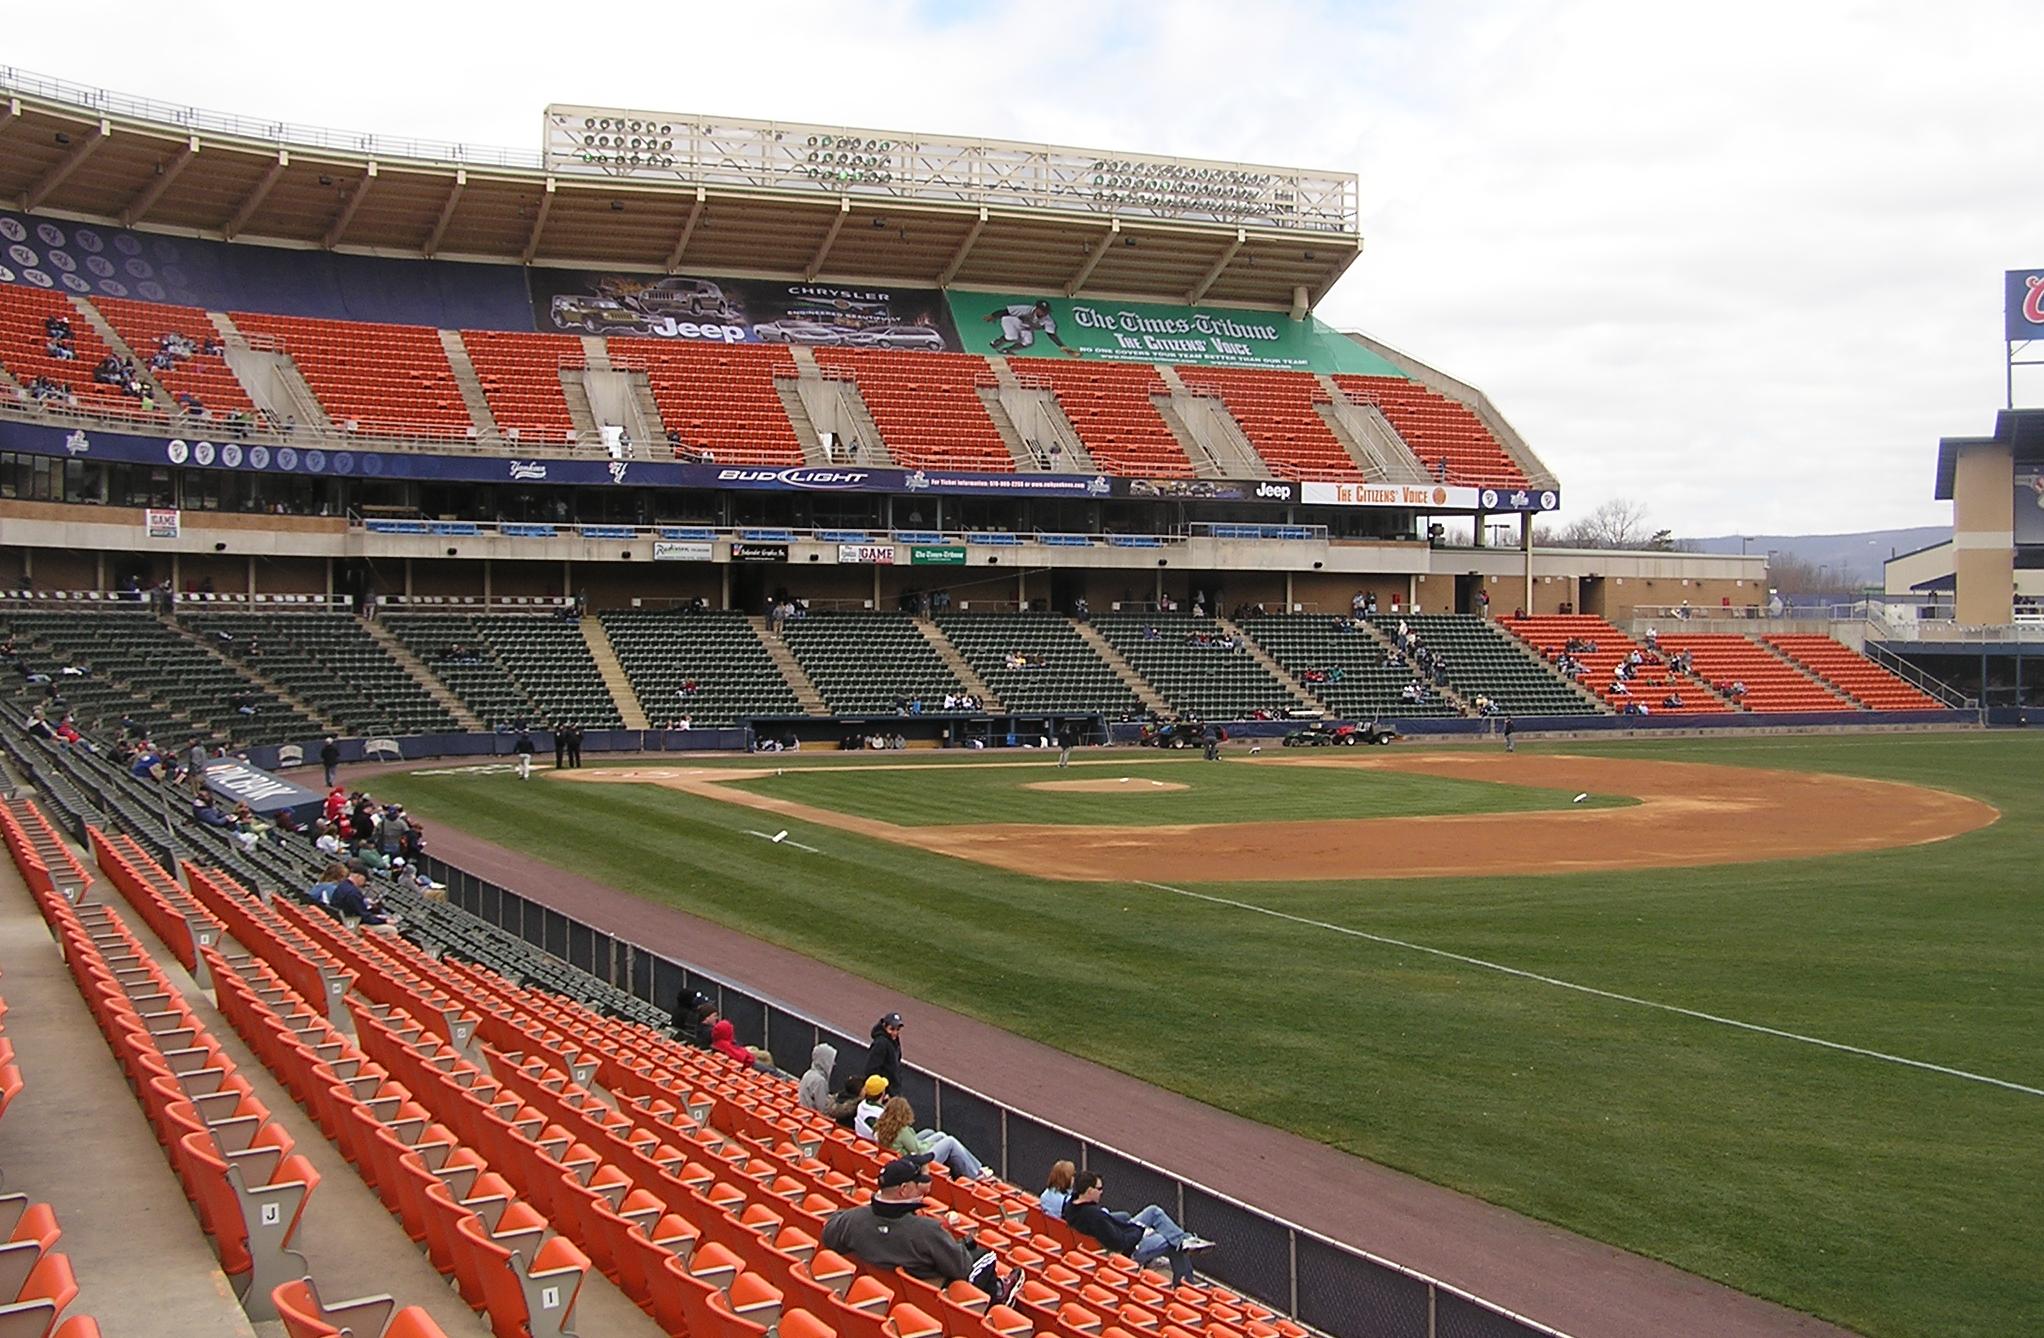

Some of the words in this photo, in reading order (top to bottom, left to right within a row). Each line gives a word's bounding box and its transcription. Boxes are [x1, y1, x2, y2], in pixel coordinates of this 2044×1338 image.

[788, 287, 891, 300] CHRYSLER
[654, 318, 745, 344] Jeep
[1072, 306, 1117, 330] The
[1118, 311, 1279, 340] Times-Tribune
[1114, 332, 1142, 349] THE
[1145, 335, 1207, 352] CITIZENS'
[1210, 338, 1252, 356] VOICE
[718, 470, 778, 481] BUD
[790, 472, 868, 482] LIGHT
[1256, 482, 1291, 500] Jeep
[1336, 486, 1352, 502] THE
[1356, 486, 1399, 503] CITIZENS'
[1402, 487, 1428, 504] VOICE
[861, 548, 893, 559] GAME
